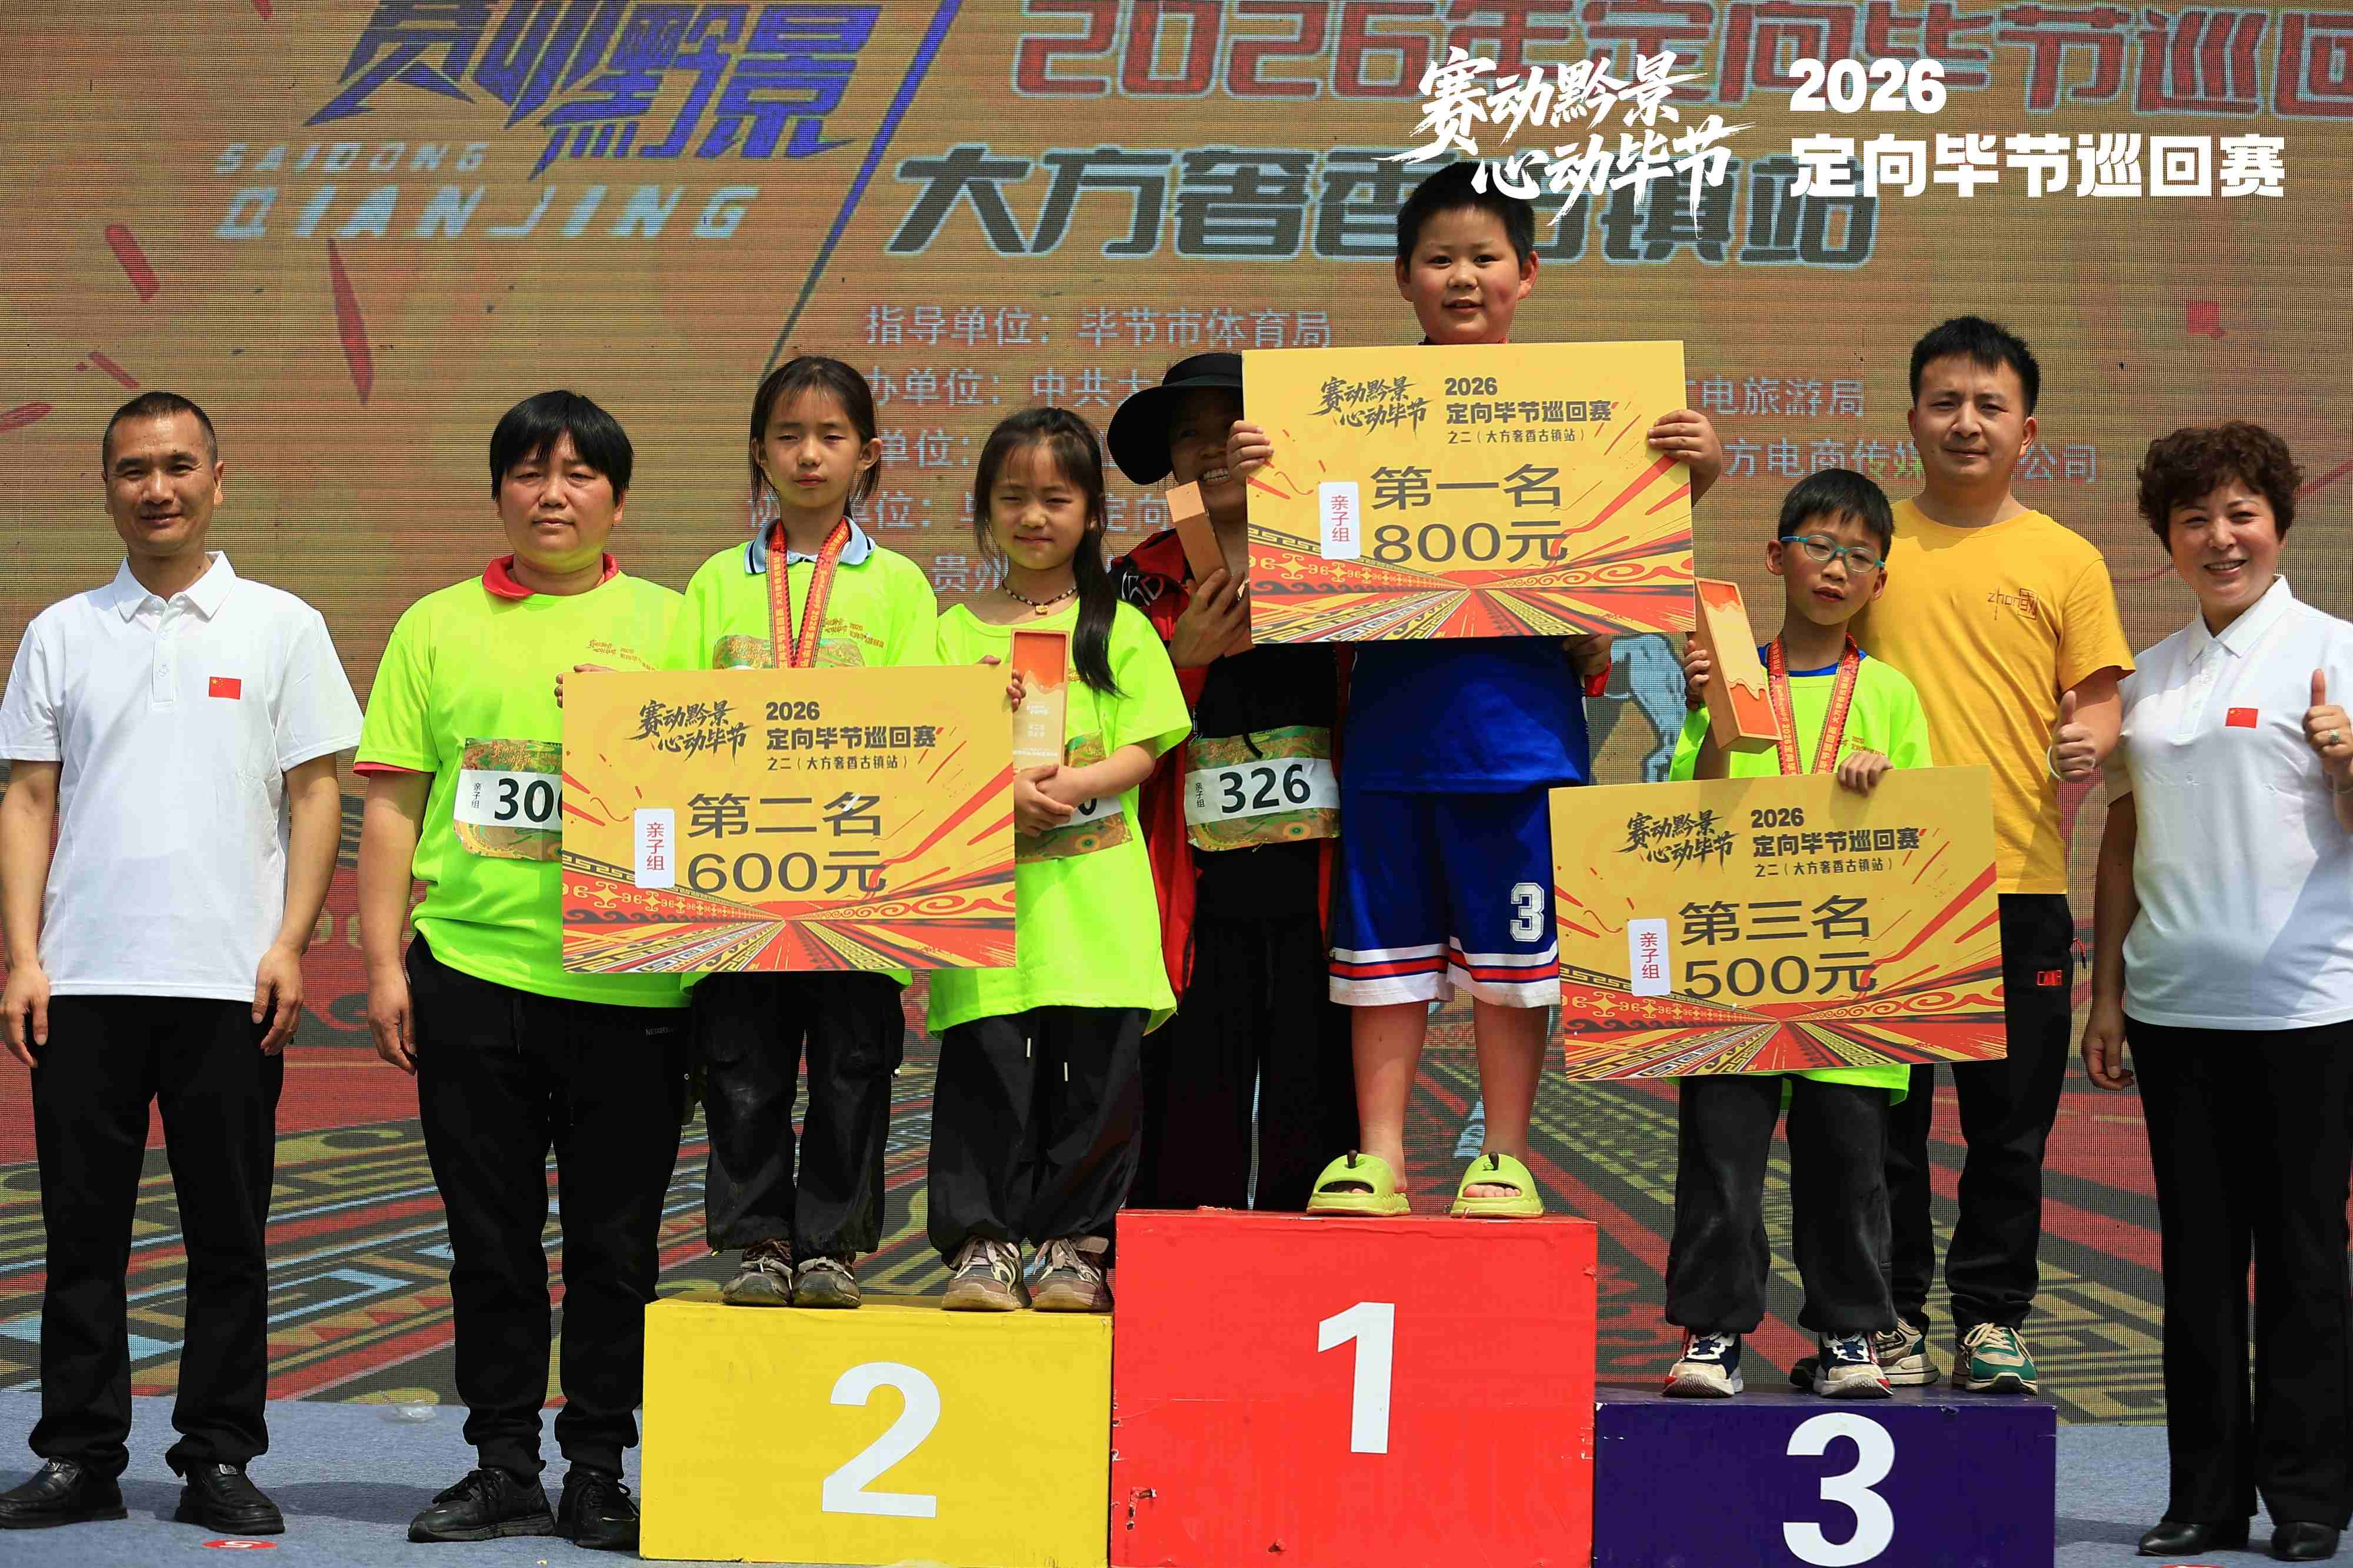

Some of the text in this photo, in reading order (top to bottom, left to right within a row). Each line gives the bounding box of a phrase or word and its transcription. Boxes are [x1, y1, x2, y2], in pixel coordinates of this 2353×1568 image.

[1077, 308, 1332, 348] 毕节市体育局
[1307, 376, 1416, 415] 赛动黔景
[1444, 377, 1498, 396] 2026
[1339, 398, 1435, 438] 心动毕节
[1445, 401, 1612, 424] 定向毕节巡回赛
[1370, 463, 1561, 511] 第一名
[1331, 494, 1351, 543] 亲子组
[1372, 520, 1569, 563] 800元
[625, 700, 737, 740] 赛动黔景
[766, 702, 819, 720] 2026
[658, 721, 755, 764] 心动毕节
[766, 726, 936, 750] 定向毕节巡回赛
[471, 782, 482, 809] 亲子组
[494, 778, 562, 823] 30
[1219, 763, 1311, 814] 326
[687, 791, 882, 839] 第二名
[1614, 809, 1723, 854] 赛动黔景
[1751, 807, 1804, 829] 2026
[646, 822, 665, 872] 亲子组
[1647, 829, 1741, 873] 心动毕节
[1752, 826, 1921, 859] 定向毕节巡回赛
[687, 850, 887, 895] 600元
[1510, 882, 1544, 942] 3
[1678, 895, 1870, 946] 第三名
[1639, 931, 1661, 980] 亲子组
[1683, 950, 1876, 999] 500元
[1319, 1303, 1394, 1453] 1
[822, 1363, 940, 1517] 2
[1783, 1412, 1896, 1567] 3
